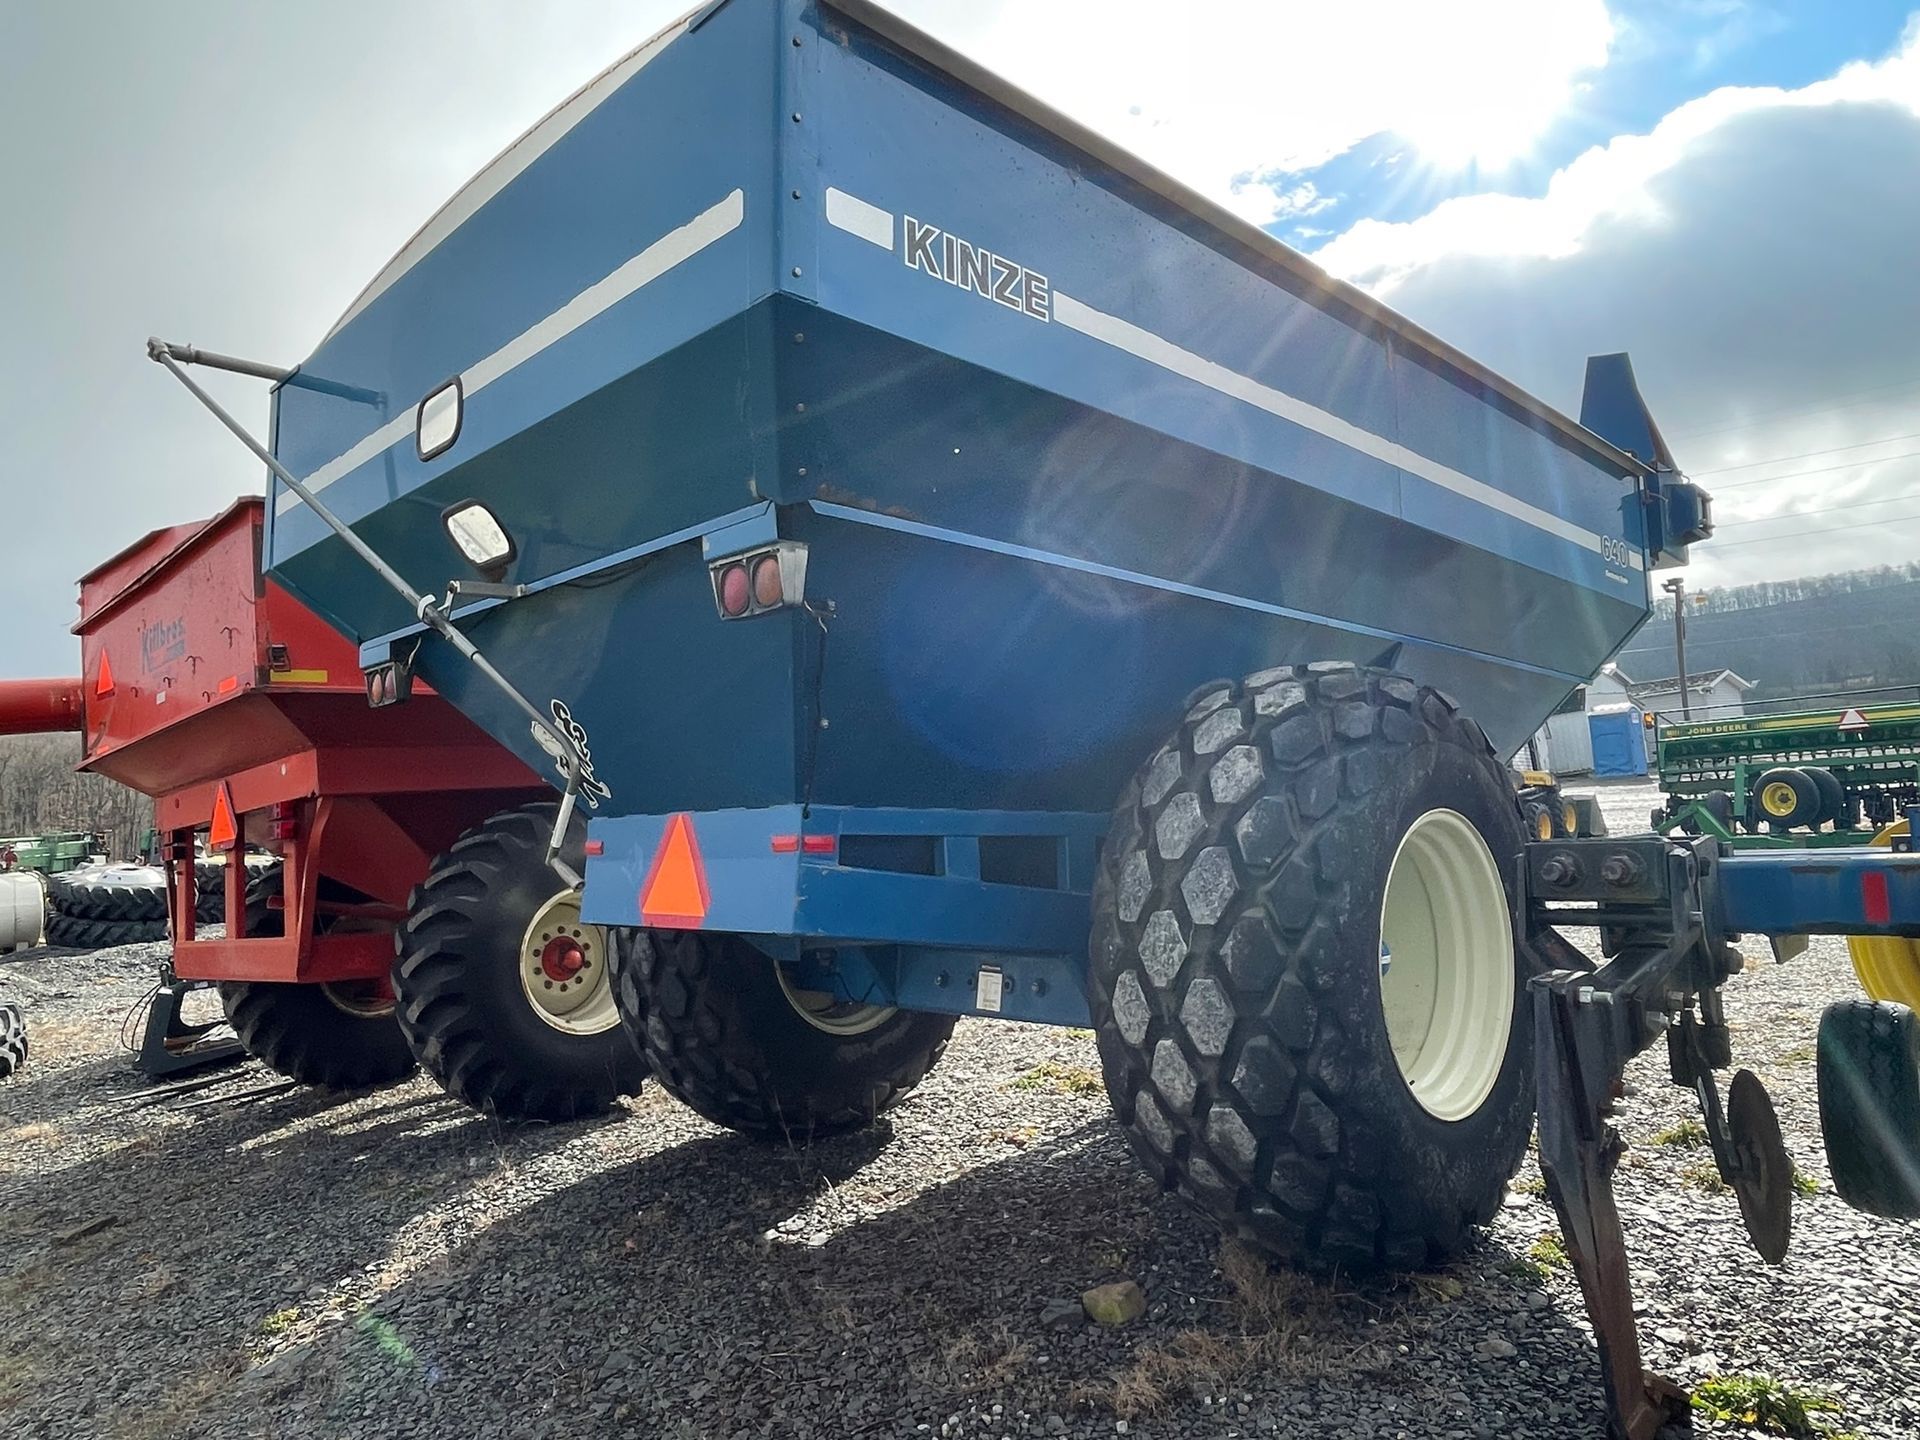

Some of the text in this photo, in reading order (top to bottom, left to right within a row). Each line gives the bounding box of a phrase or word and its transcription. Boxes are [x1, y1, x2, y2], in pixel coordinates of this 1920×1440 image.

[904, 214, 1049, 323] KINZE
[1602, 535, 1628, 568] 640
[1687, 723, 1748, 735] JOHN DEERE
